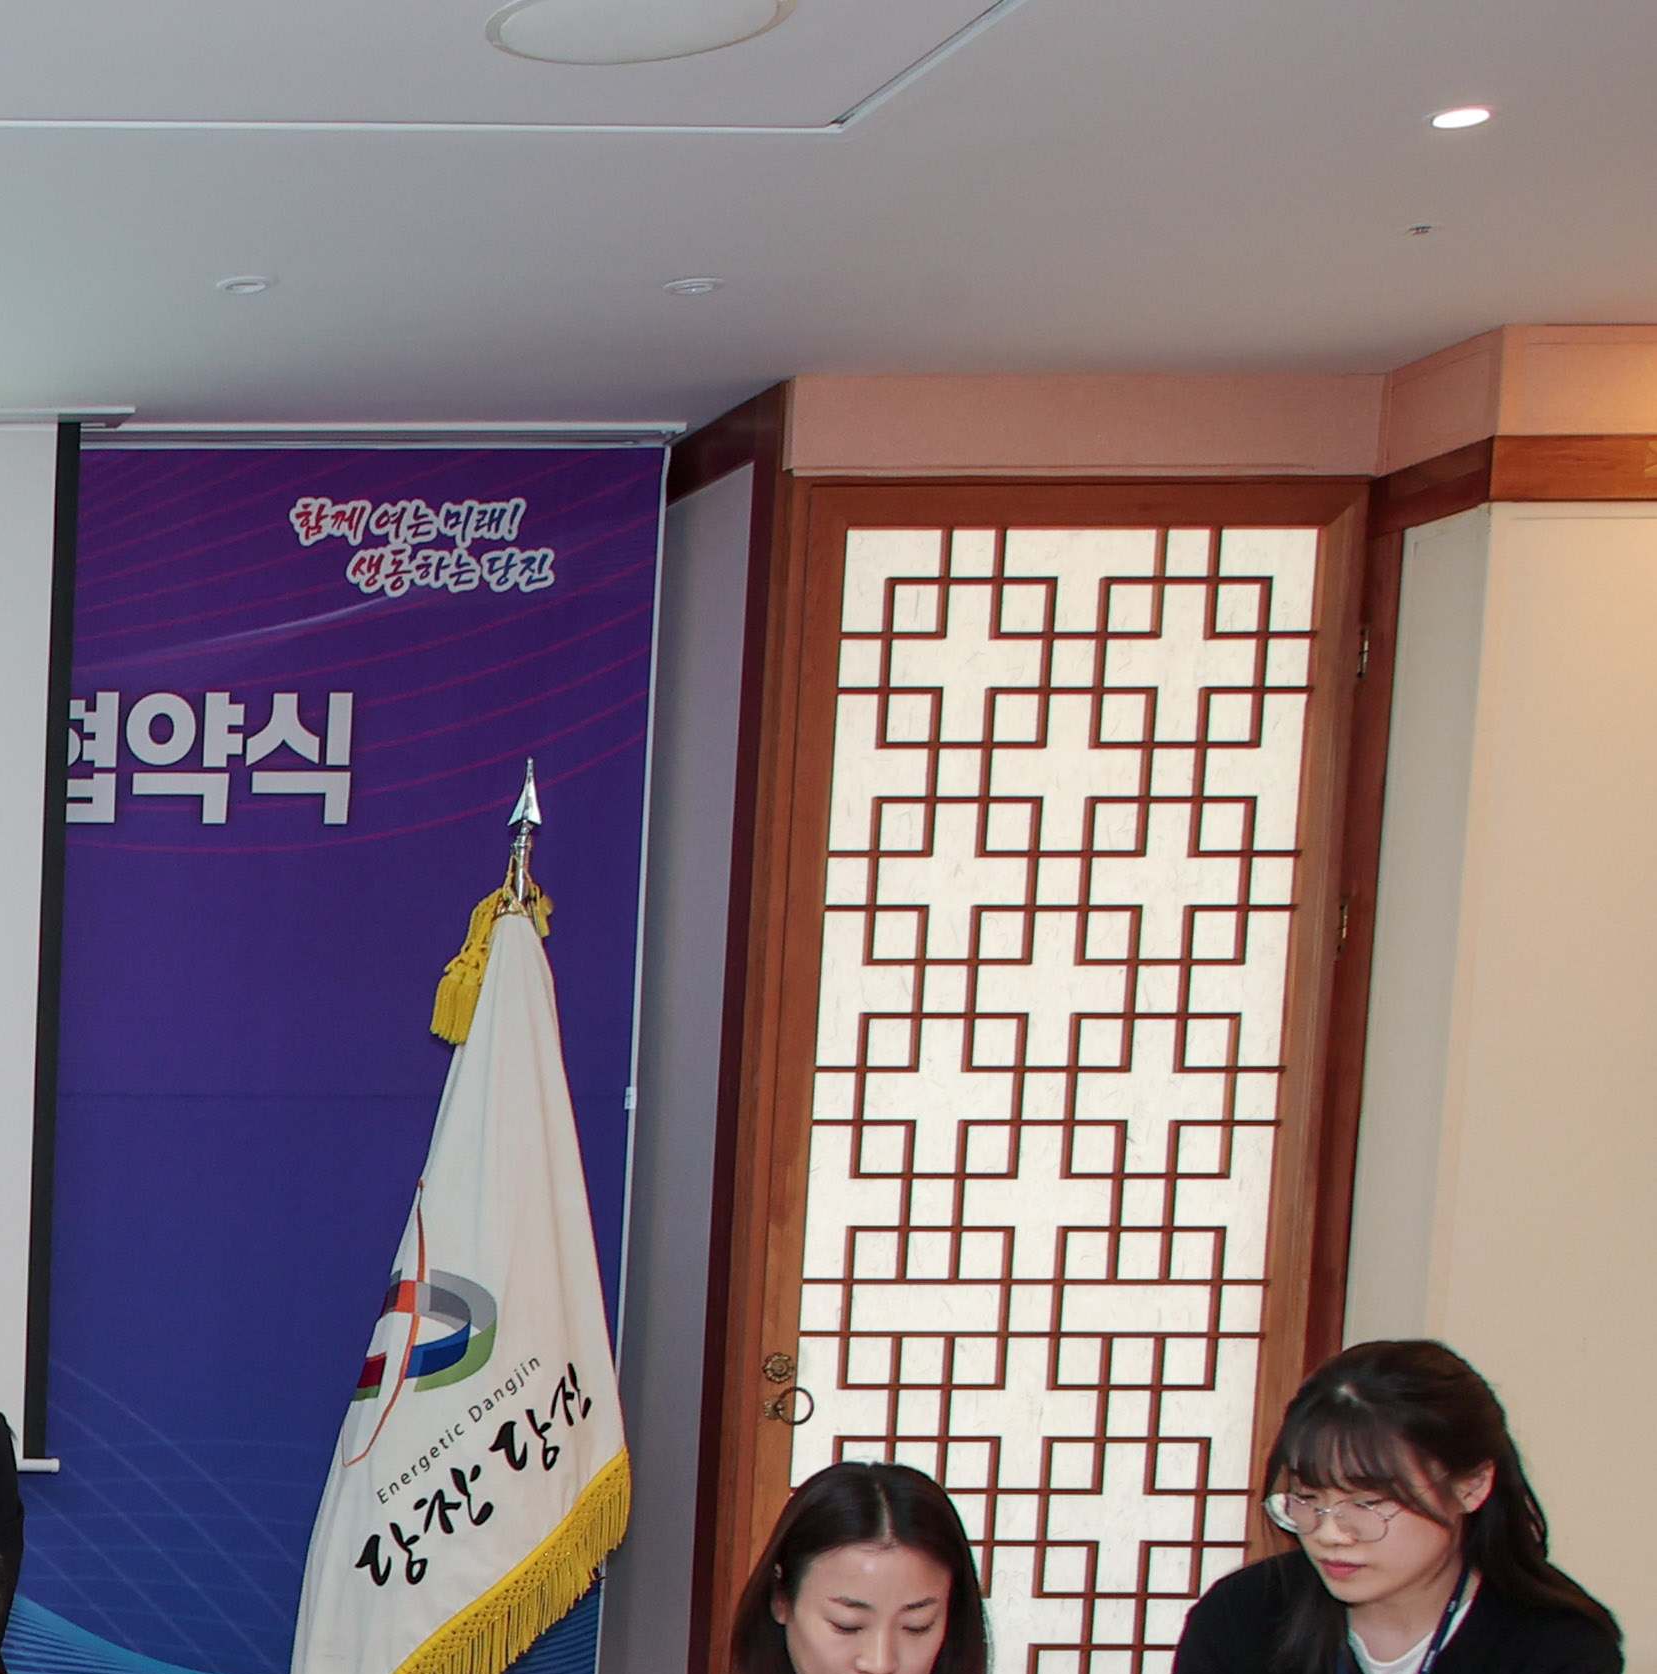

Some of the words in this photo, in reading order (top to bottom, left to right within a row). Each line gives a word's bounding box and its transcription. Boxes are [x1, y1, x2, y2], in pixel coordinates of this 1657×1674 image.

[291, 500, 365, 544] 함께
[372, 502, 442, 543] 여는
[441, 500, 525, 546] 미래!
[347, 547, 480, 595] 생동하는
[483, 550, 553, 590] 당진
[376, 1421, 466, 1505] Energetic
[467, 1355, 542, 1424] Dangjin
[489, 1362, 593, 1471] 당진
